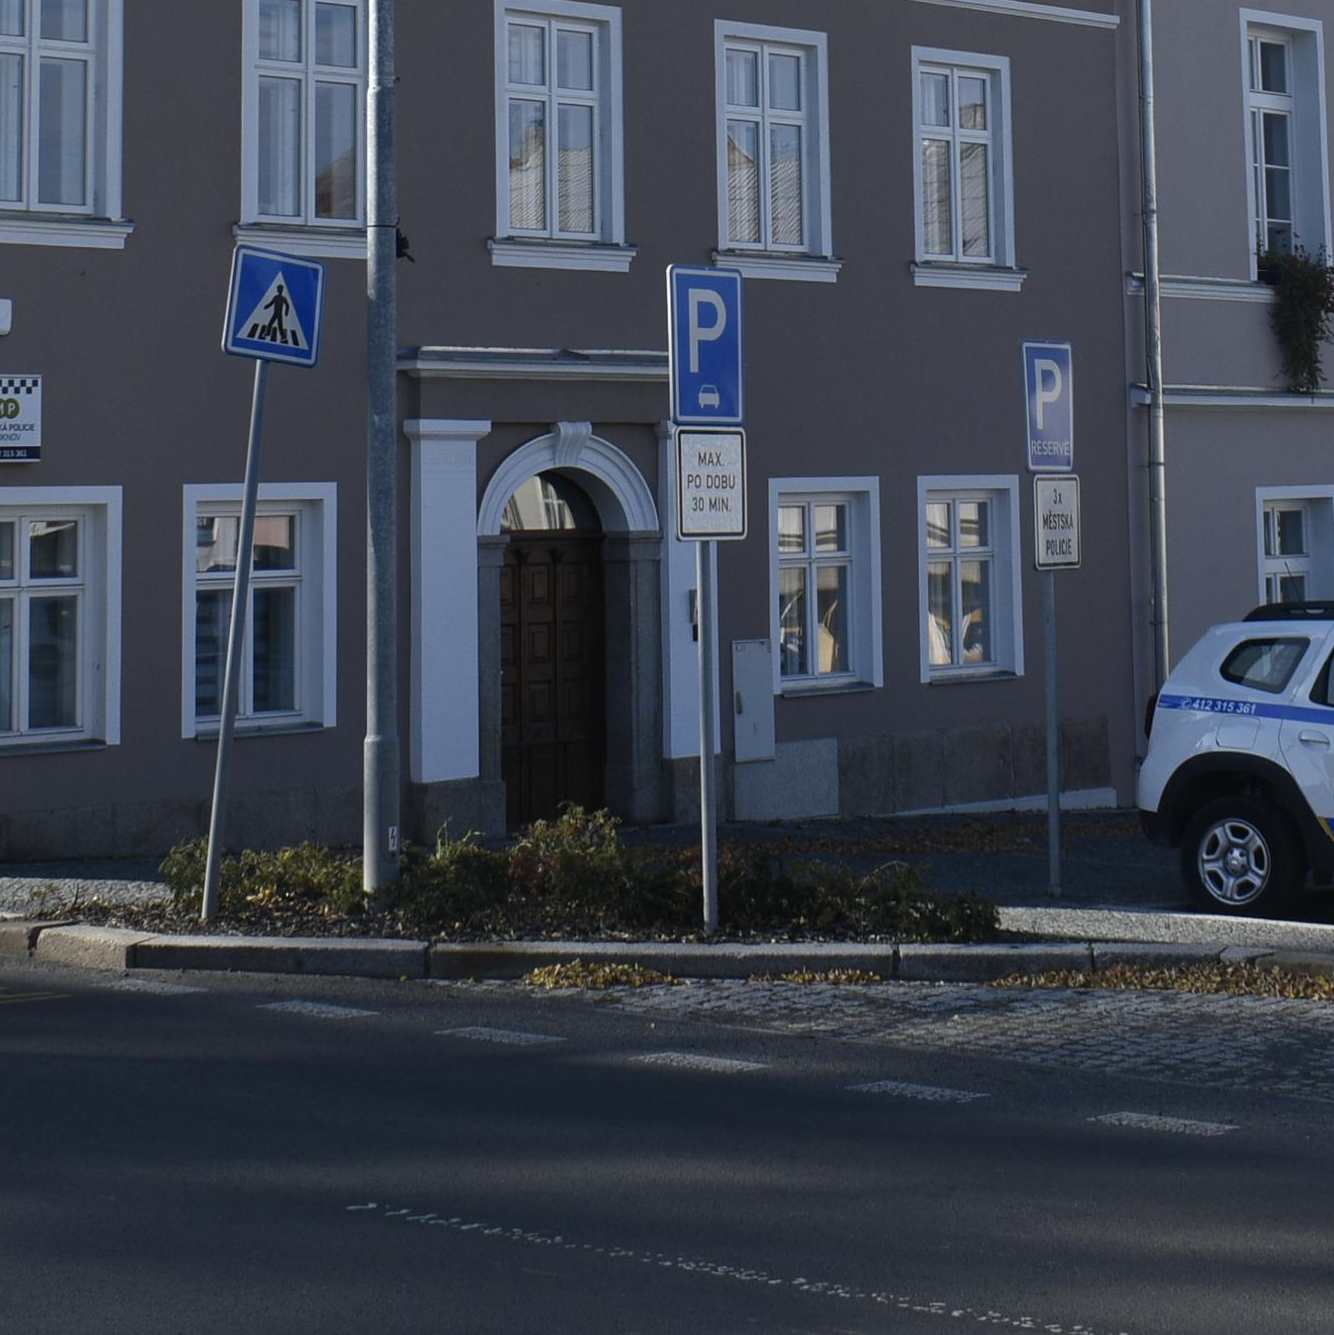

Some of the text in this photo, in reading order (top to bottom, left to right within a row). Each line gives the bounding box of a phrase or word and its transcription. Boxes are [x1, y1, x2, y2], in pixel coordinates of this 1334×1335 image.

[687, 287, 727, 374] P
[1034, 358, 1062, 430] P
[9, 423, 35, 432] POLICIE
[1030, 440, 1070, 457] RESERVE
[697, 451, 725, 467] MAX.
[687, 474, 735, 490] PO DOBU
[692, 497, 732, 513] 30 MIN.
[1042, 510, 1074, 531] MĚSTSKÁ
[1045, 538, 1072, 557] POLICIE
[1192, 698, 1257, 715] 412 315 361
